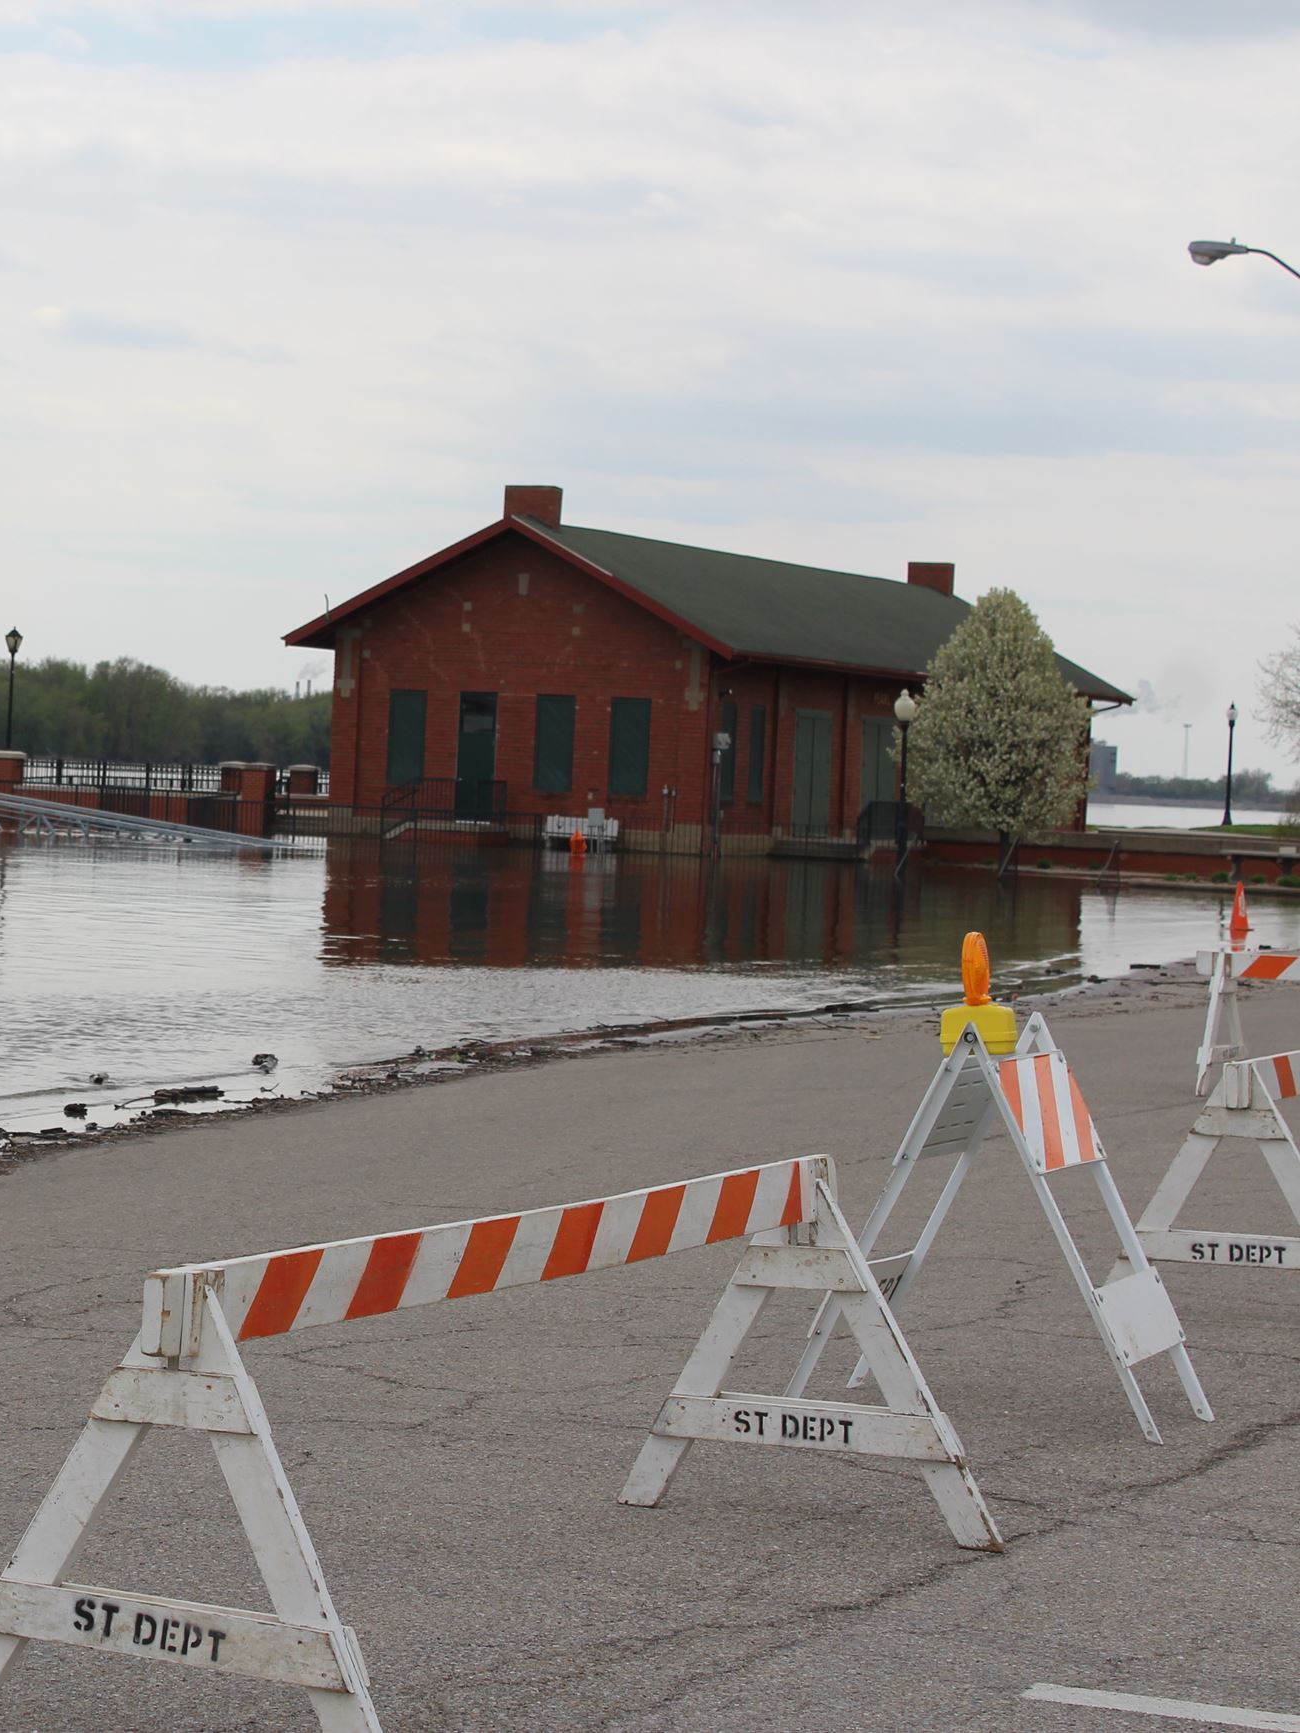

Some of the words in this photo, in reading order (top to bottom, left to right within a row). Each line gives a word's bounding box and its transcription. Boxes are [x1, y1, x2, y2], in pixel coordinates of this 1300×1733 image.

[1191, 1243, 1219, 1261] ST
[1229, 1244, 1286, 1264] DEPT
[733, 1410, 768, 1435] ST
[781, 1414, 853, 1444] DEPT
[73, 1599, 120, 1637] ST
[132, 1612, 227, 1662] DEPT
